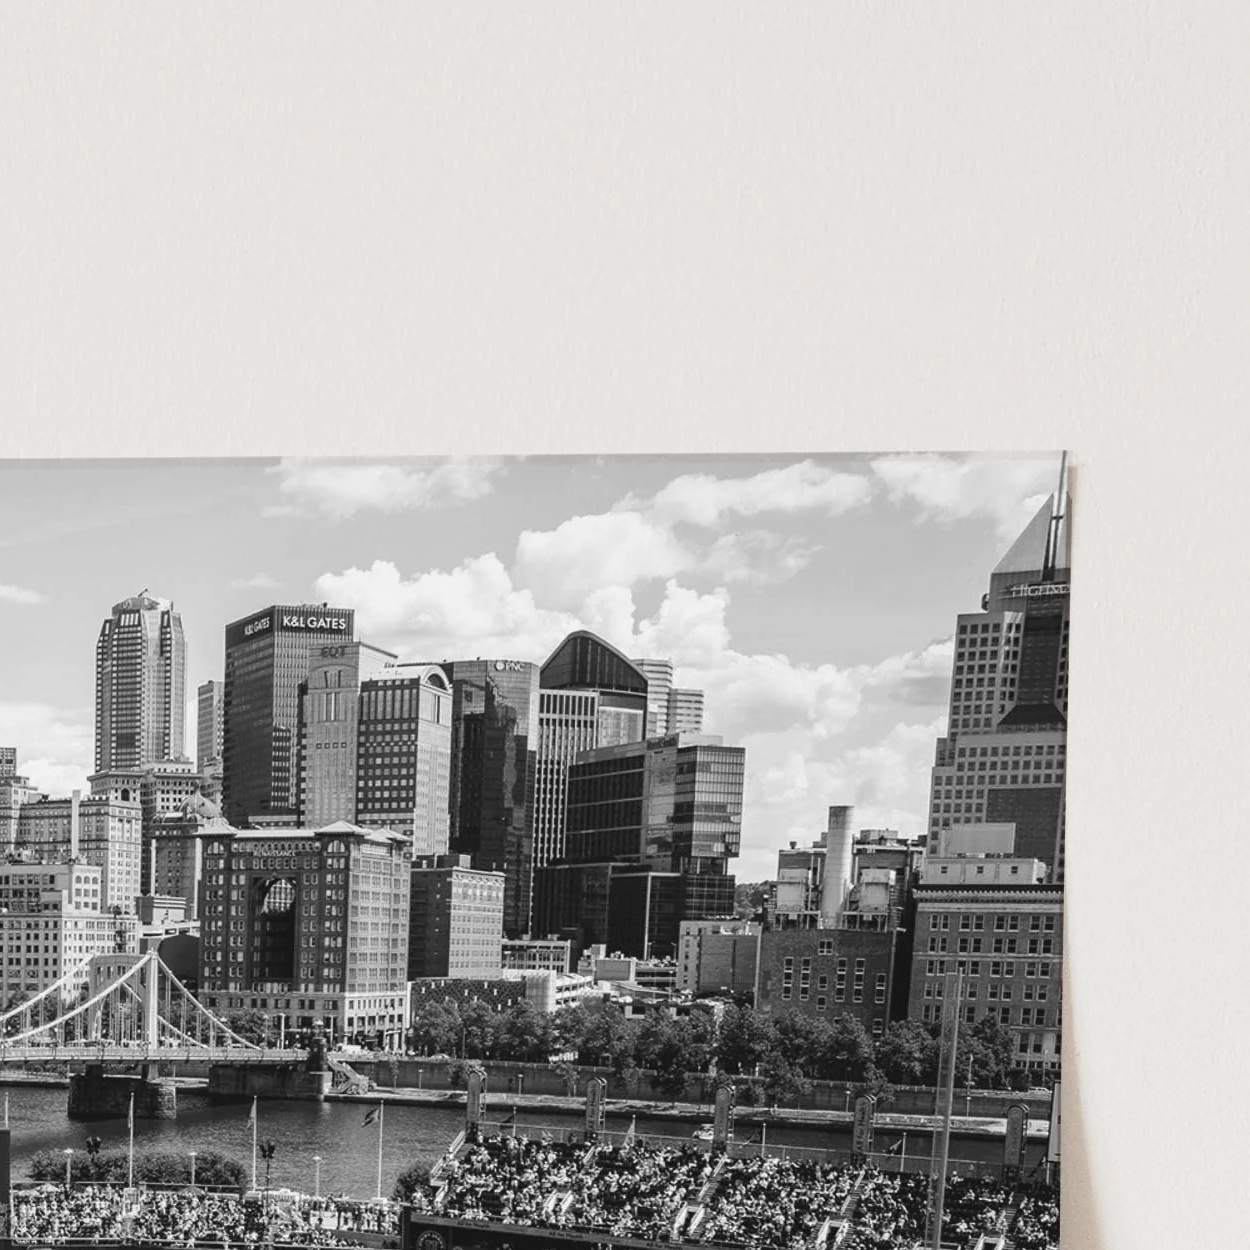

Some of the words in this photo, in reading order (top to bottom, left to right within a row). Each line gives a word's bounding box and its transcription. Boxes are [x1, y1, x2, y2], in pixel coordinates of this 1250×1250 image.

[282, 616, 305, 628] K&L
[307, 617, 347, 630] GATES
[505, 662, 524, 672] PNC
